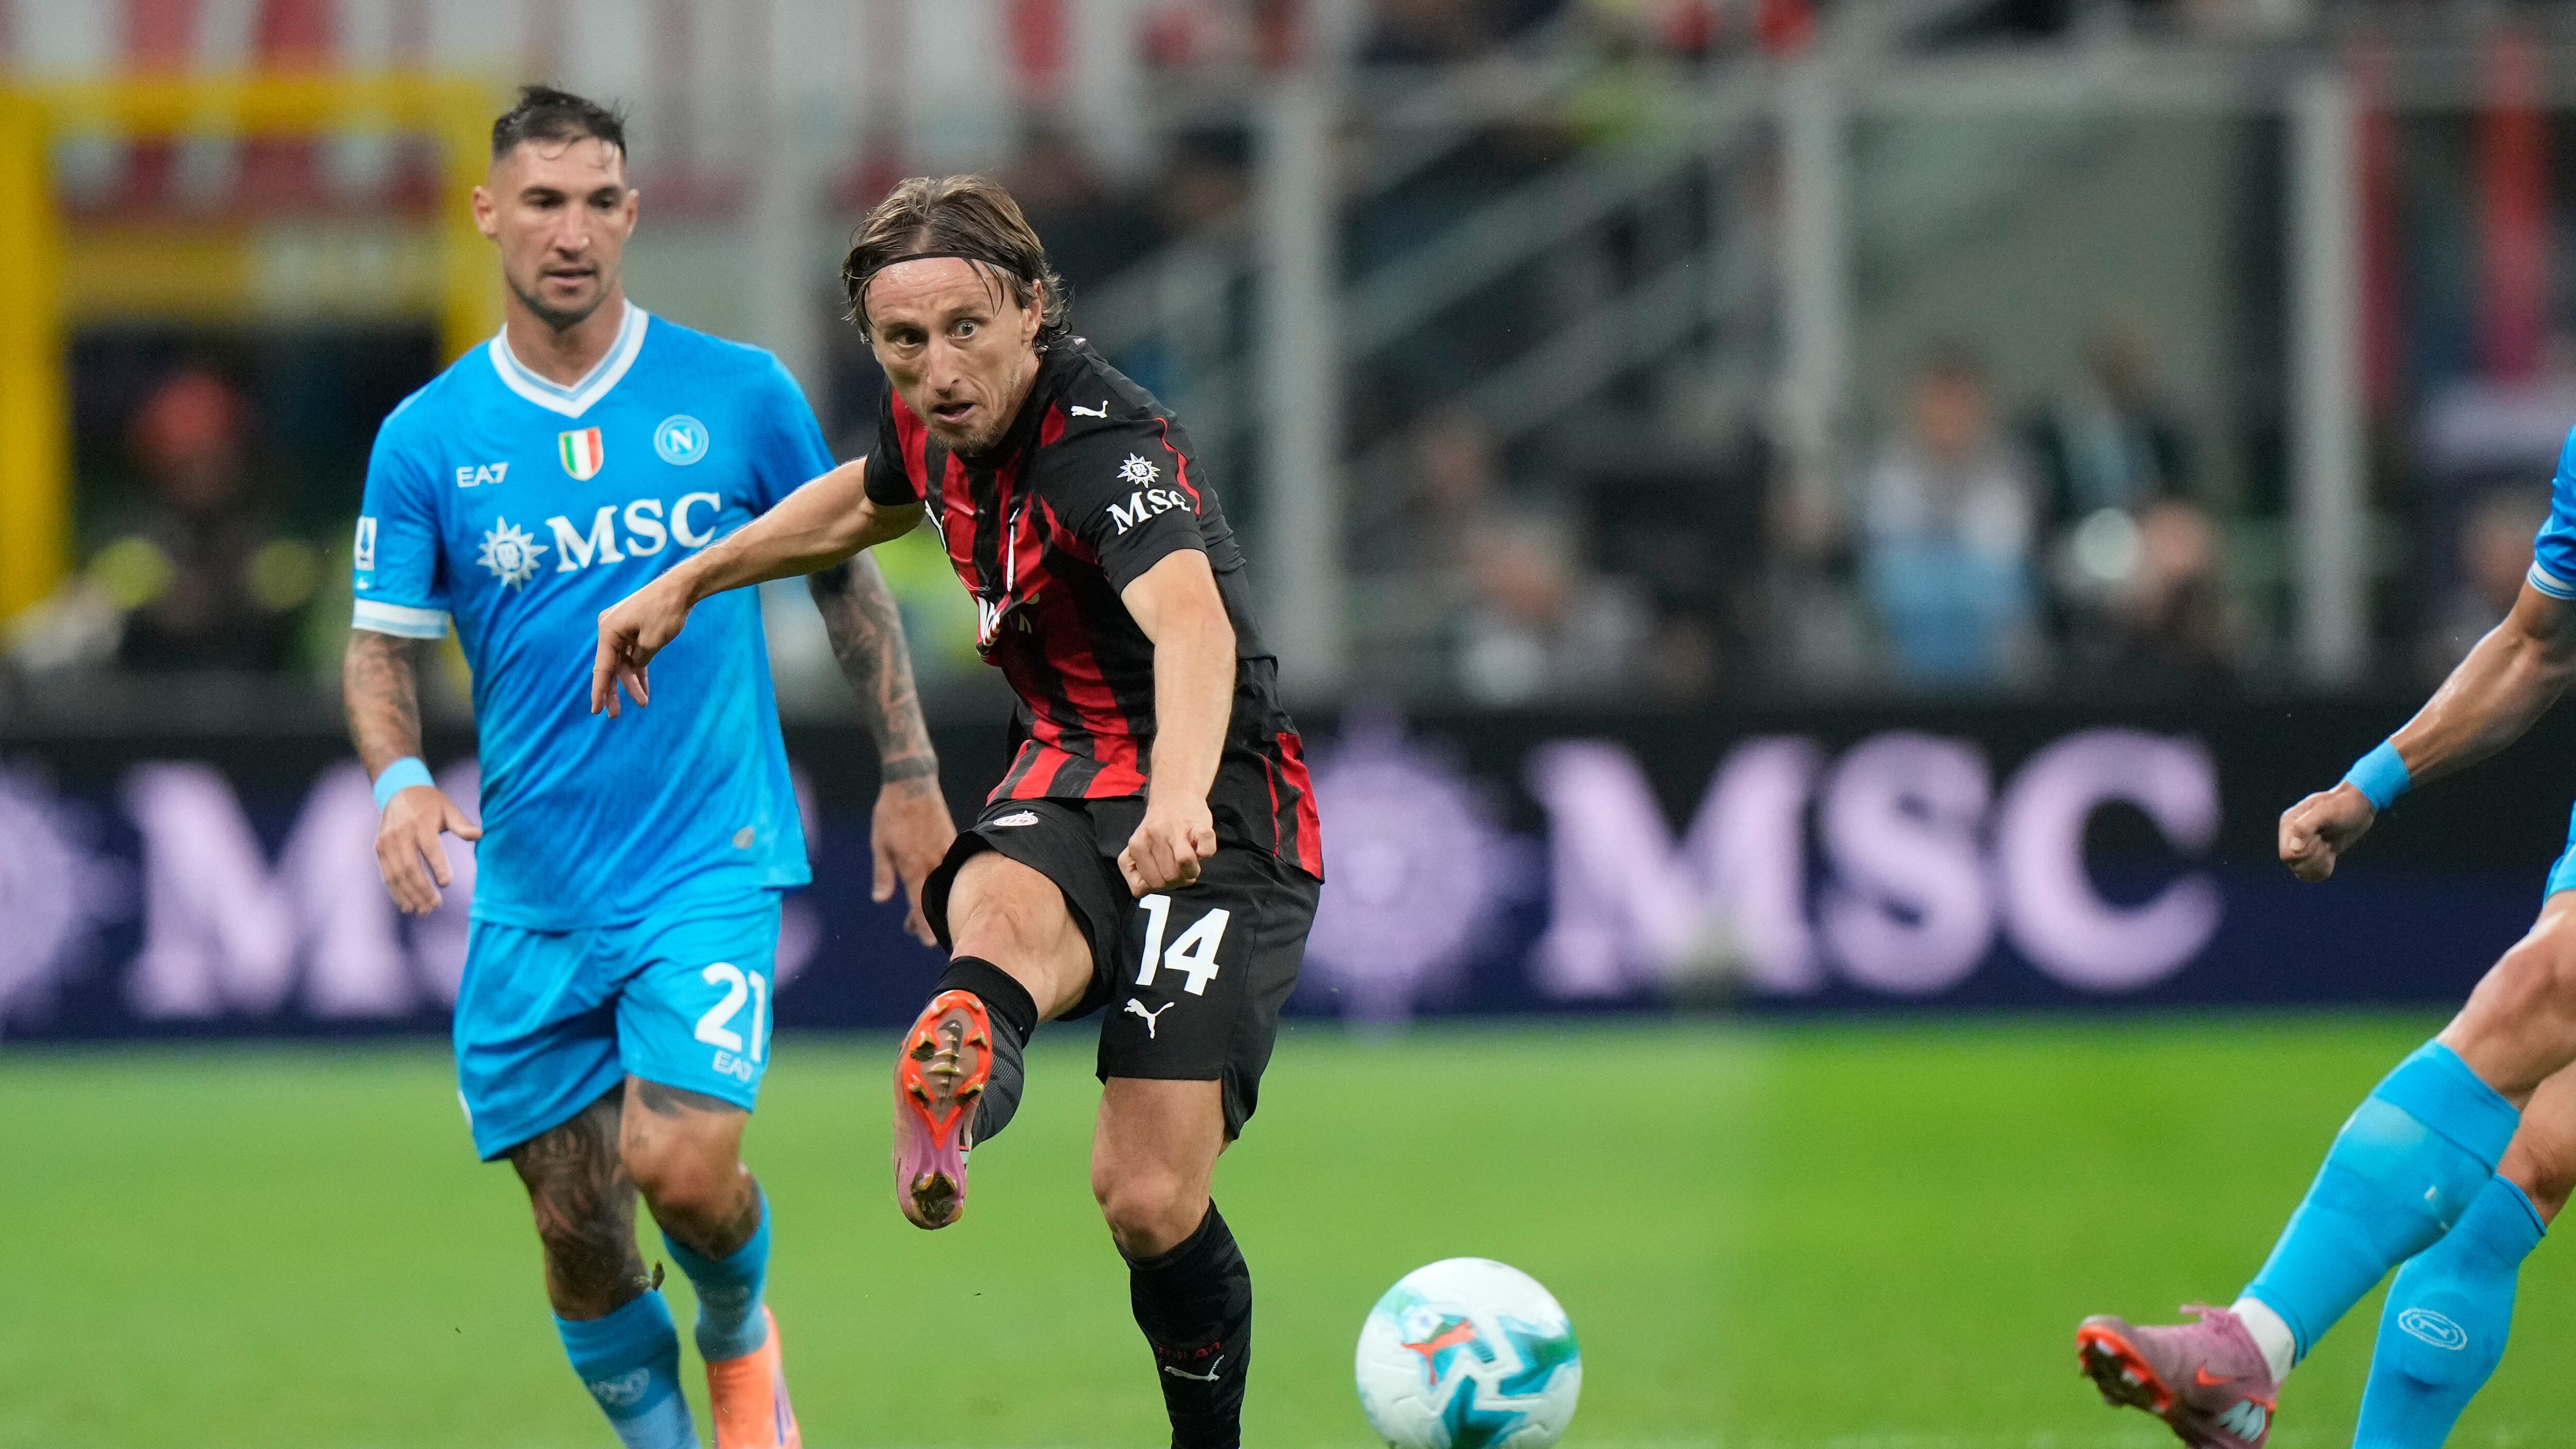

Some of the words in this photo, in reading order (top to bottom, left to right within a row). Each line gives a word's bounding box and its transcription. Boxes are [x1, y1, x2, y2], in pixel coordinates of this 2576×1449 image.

[456, 462, 509, 487] EA7
[545, 492, 721, 573] MSC
[1529, 727, 2225, 996] MSC
[1135, 894, 1230, 996] 14
[694, 962, 766, 1063] 21
